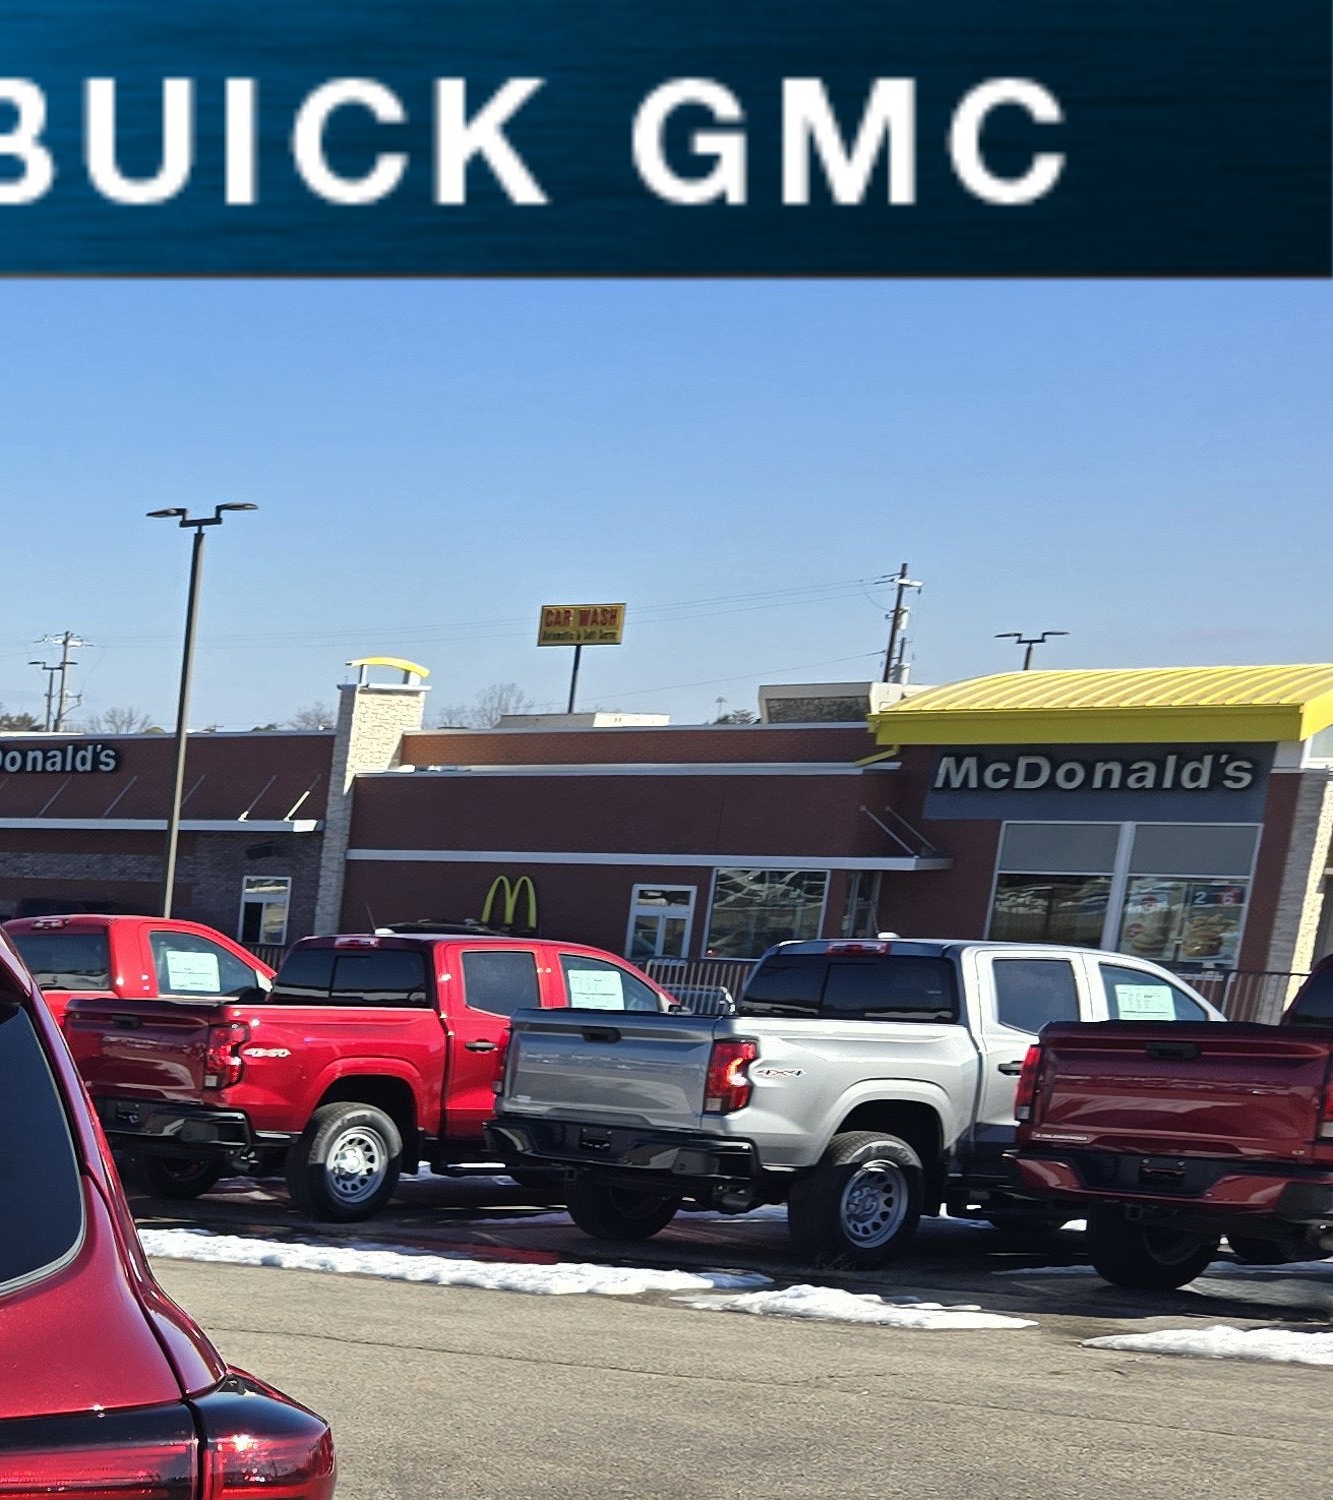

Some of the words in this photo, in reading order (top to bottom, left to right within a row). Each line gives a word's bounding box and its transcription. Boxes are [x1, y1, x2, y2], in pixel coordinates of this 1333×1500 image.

[545, 609, 572, 627] CAR
[579, 608, 618, 626] WASH
[934, 754, 1254, 790] McDonald's
